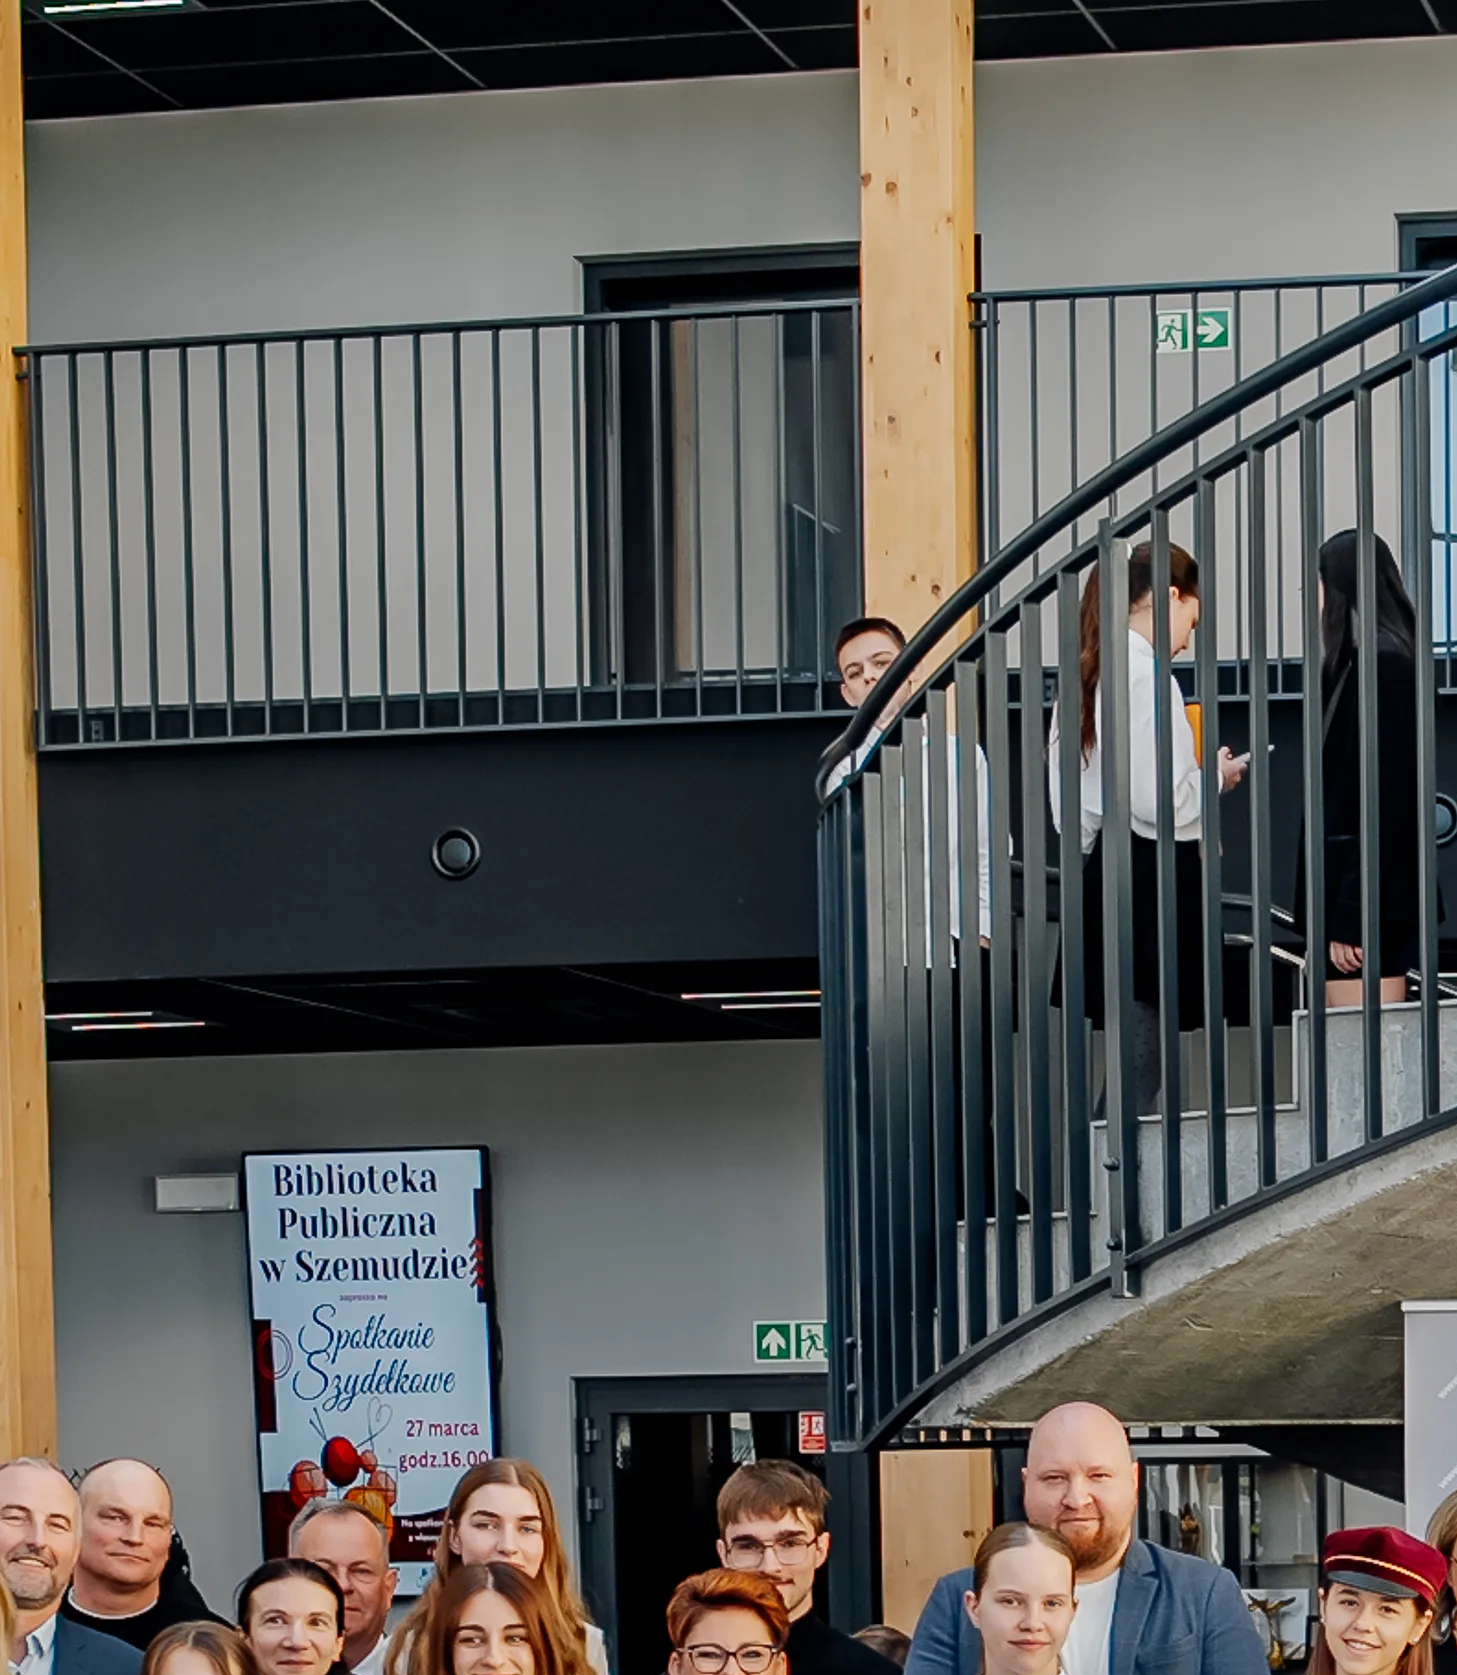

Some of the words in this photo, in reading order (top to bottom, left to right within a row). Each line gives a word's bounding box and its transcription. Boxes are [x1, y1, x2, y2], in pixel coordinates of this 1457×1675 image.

[273, 1162, 437, 1196] Biblioteka
[278, 1207, 437, 1239] Publiczna
[259, 1260, 286, 1282] w
[295, 1248, 467, 1282] Szemudzie
[298, 1304, 435, 1365] Spotkanie
[292, 1349, 456, 1412] Szydełkowe
[406, 1420, 424, 1437] 27
[429, 1422, 480, 1437] marca
[399, 1450, 490, 1473] godz.16.00
